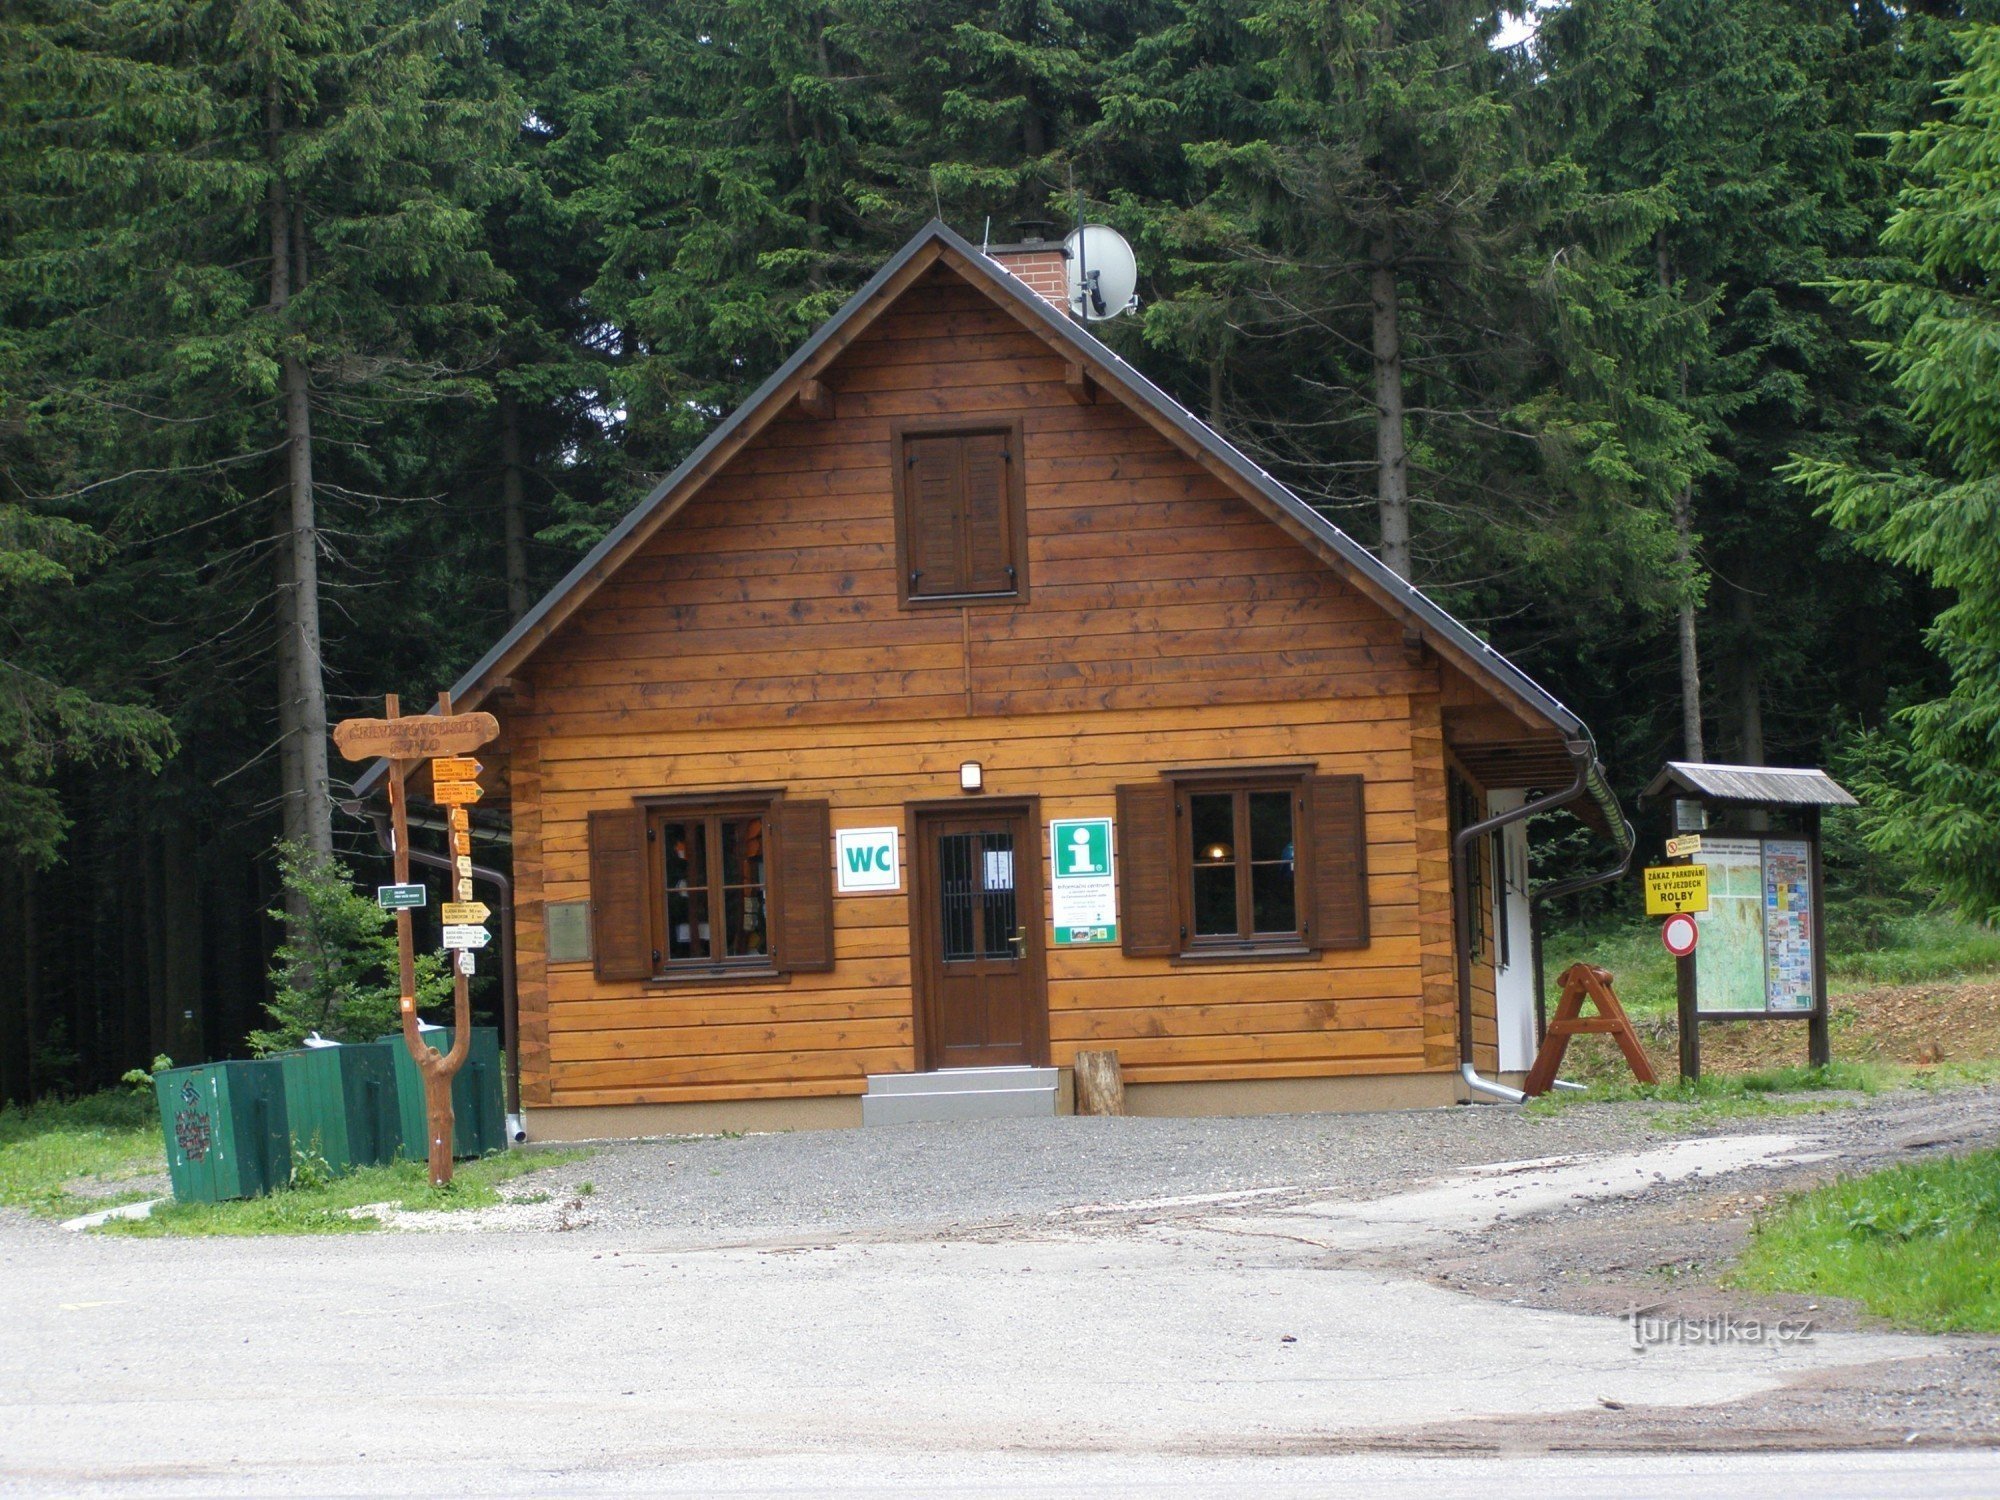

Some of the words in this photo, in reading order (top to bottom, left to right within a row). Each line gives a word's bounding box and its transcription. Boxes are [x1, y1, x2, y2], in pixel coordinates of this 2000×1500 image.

[846, 845, 891, 872] WC
[1648, 869, 1670, 880] ZÁKAZ
[1671, 867, 1705, 879] PARKOVÁNÍ
[1652, 882, 1661, 891] VE
[1663, 879, 1702, 890] VÝJEZDECH
[1660, 891, 1694, 902] ROLBY
